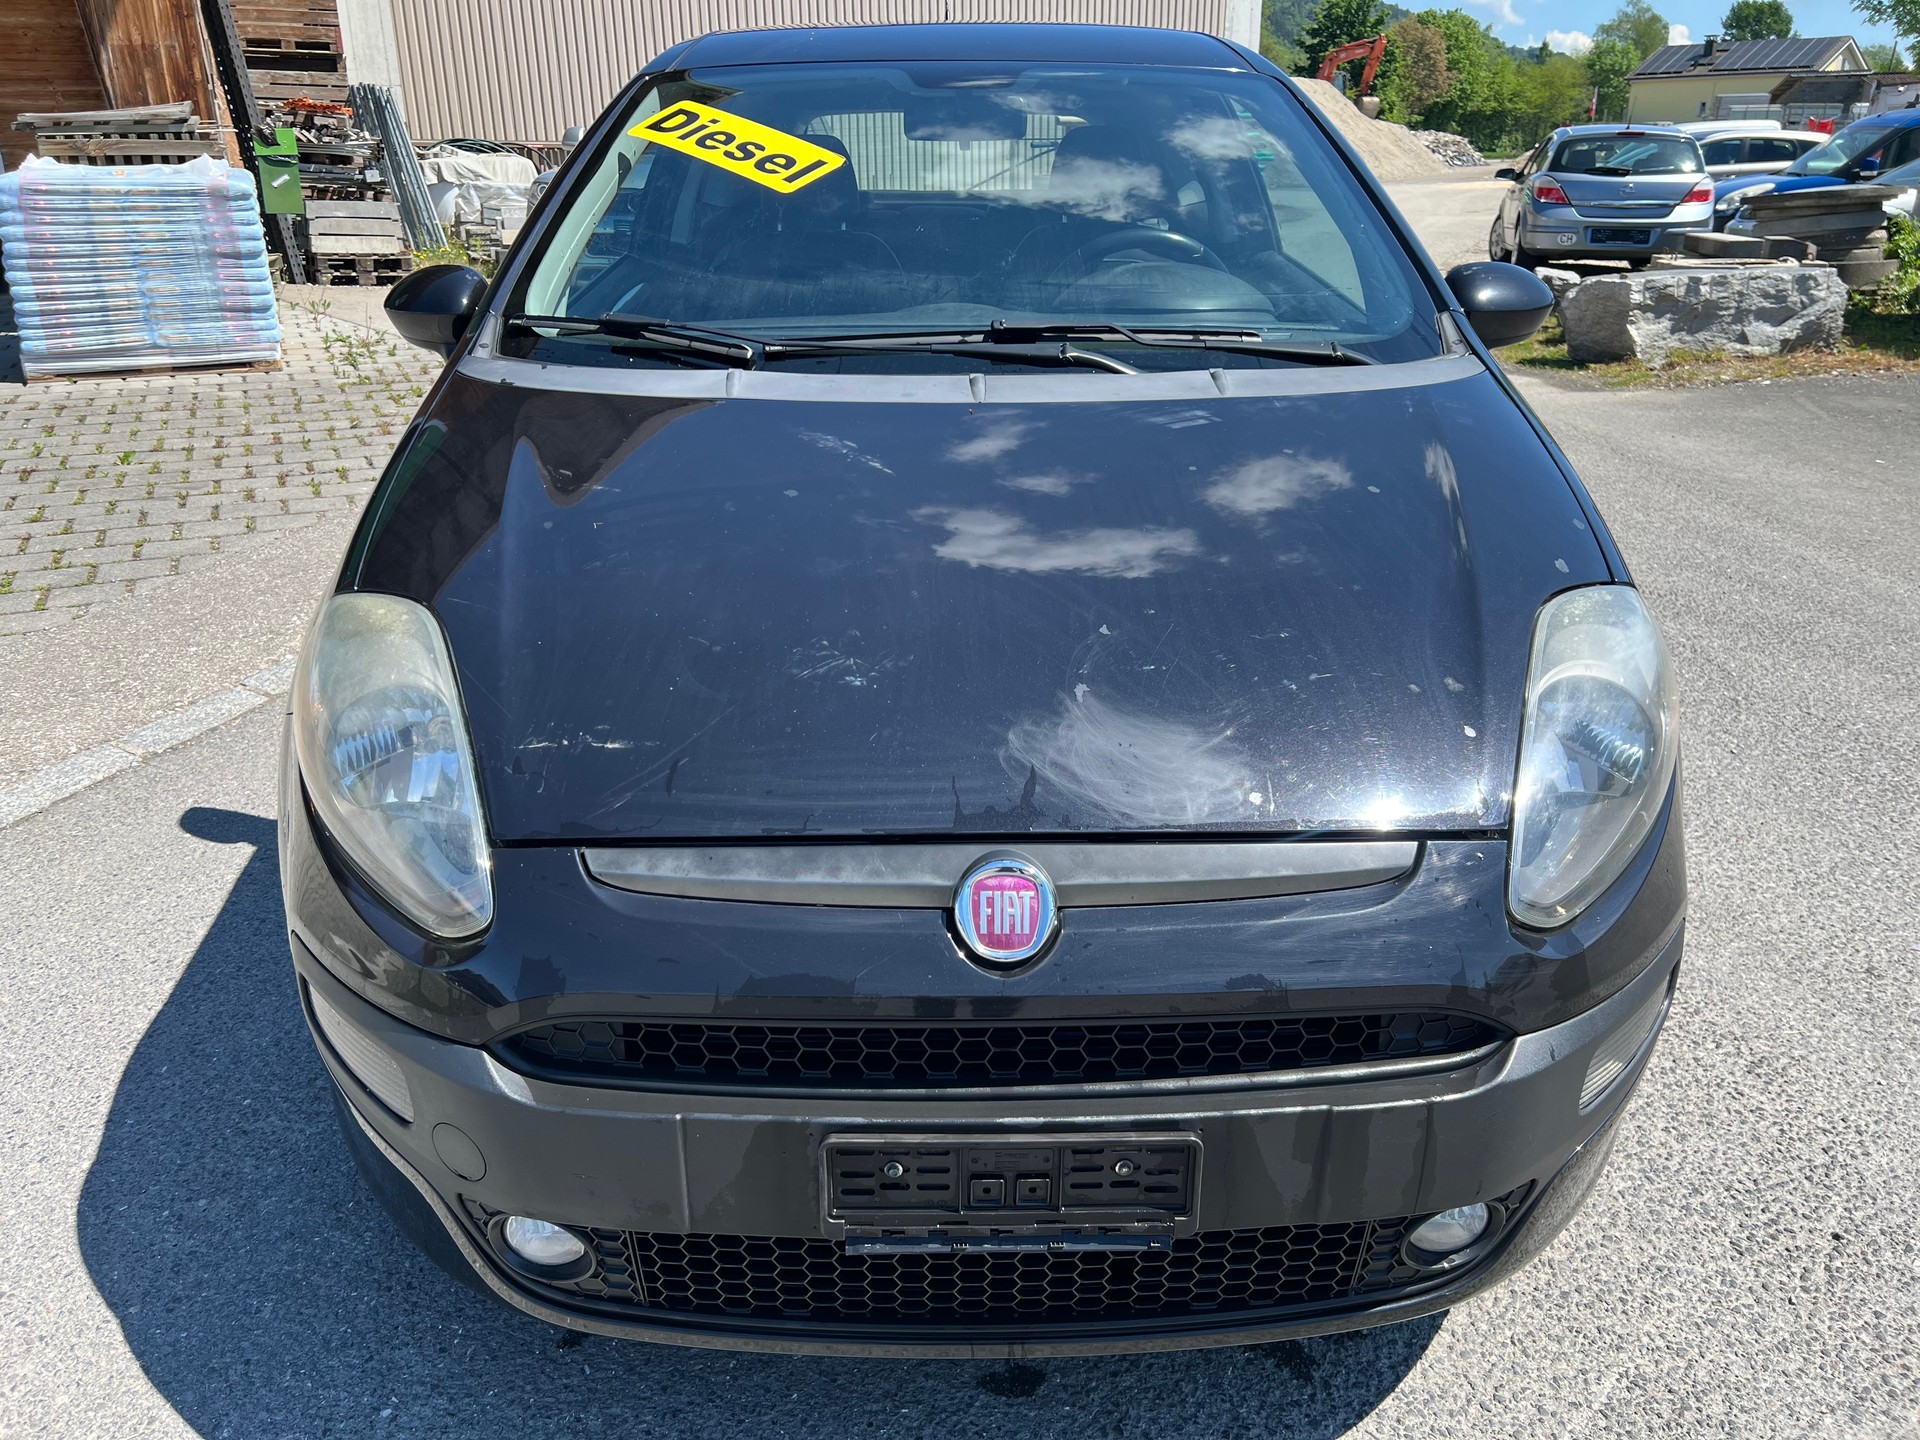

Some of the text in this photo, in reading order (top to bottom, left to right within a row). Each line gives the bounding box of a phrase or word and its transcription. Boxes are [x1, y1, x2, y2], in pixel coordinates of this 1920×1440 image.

[644, 108, 828, 184] Diesel
[1560, 233, 1573, 244] CH
[979, 891, 1035, 934] FIAT
